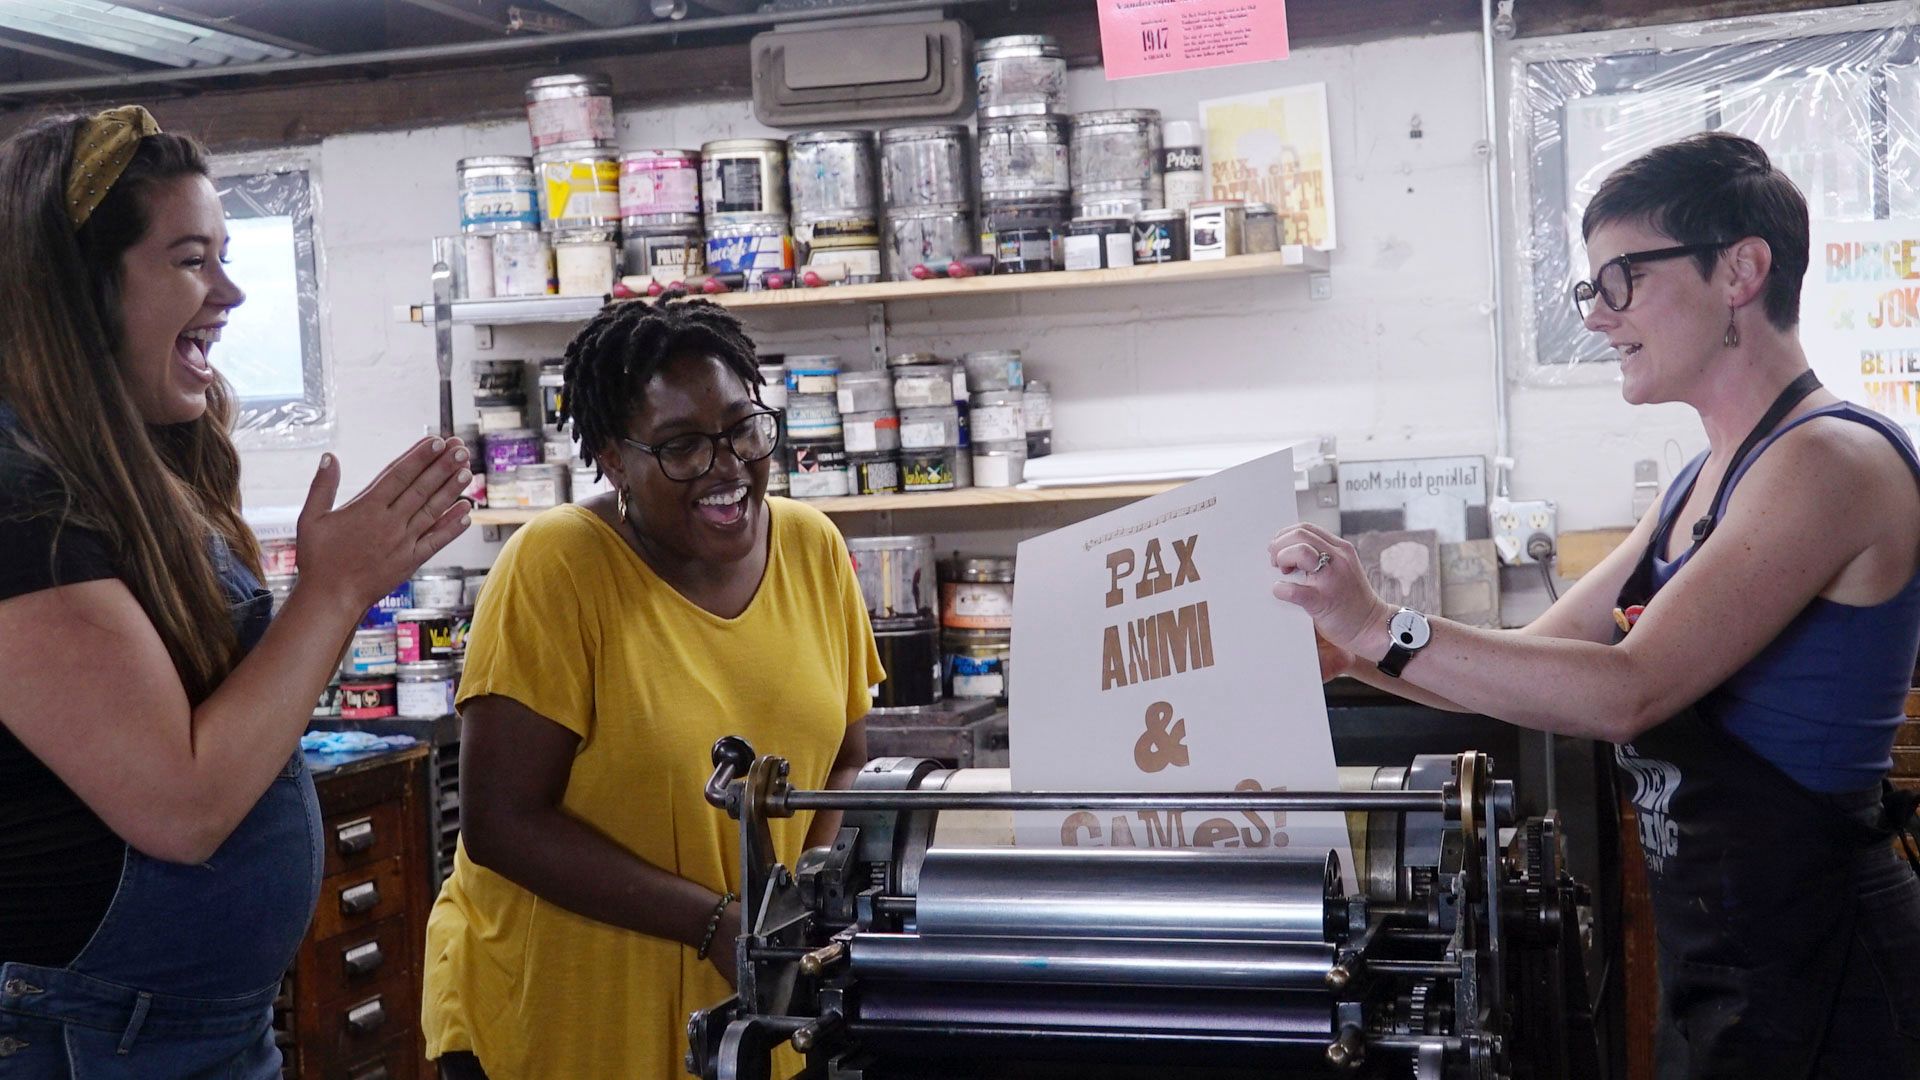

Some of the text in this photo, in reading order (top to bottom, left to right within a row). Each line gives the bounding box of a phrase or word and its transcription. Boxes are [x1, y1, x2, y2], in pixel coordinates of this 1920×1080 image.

[1105, 534, 1201, 609] PAX
[1101, 600, 1215, 691] ANIMI
[1133, 701, 1190, 774] &
